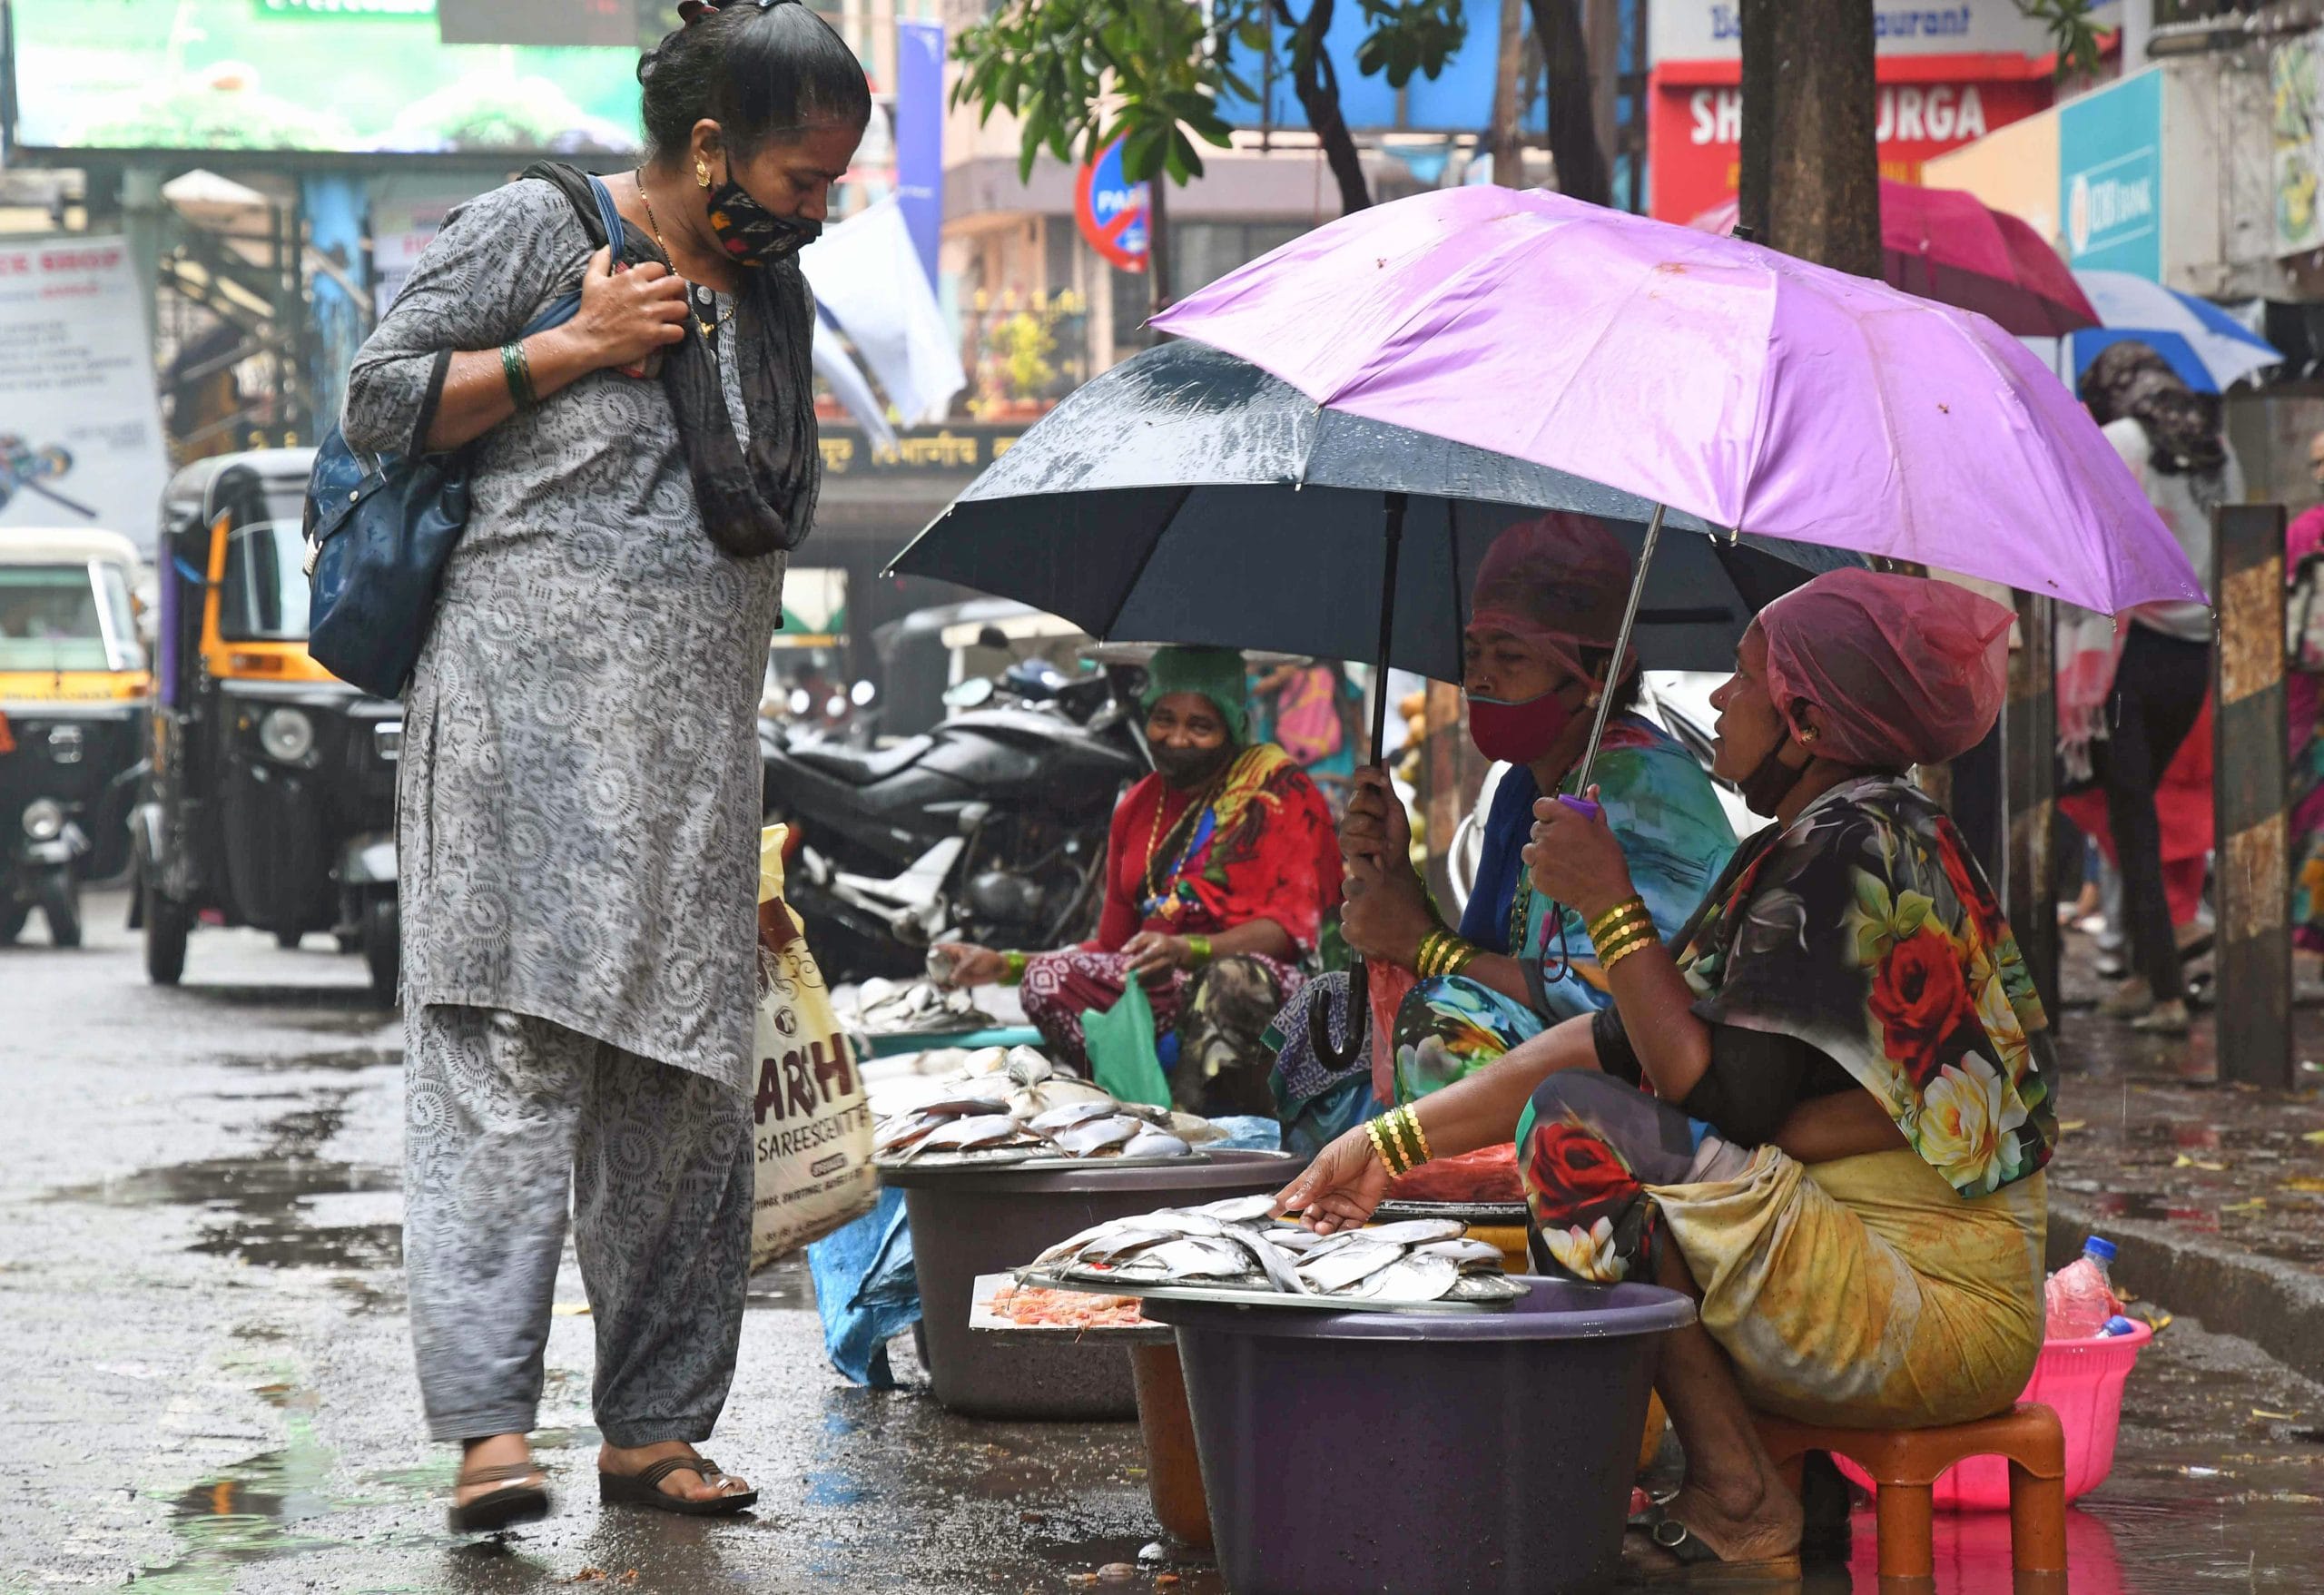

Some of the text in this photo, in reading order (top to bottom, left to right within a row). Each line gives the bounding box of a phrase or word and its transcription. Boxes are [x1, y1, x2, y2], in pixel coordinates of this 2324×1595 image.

[1873, 6, 1971, 38] aurant
[1690, 85, 1986, 145] SH URGA
